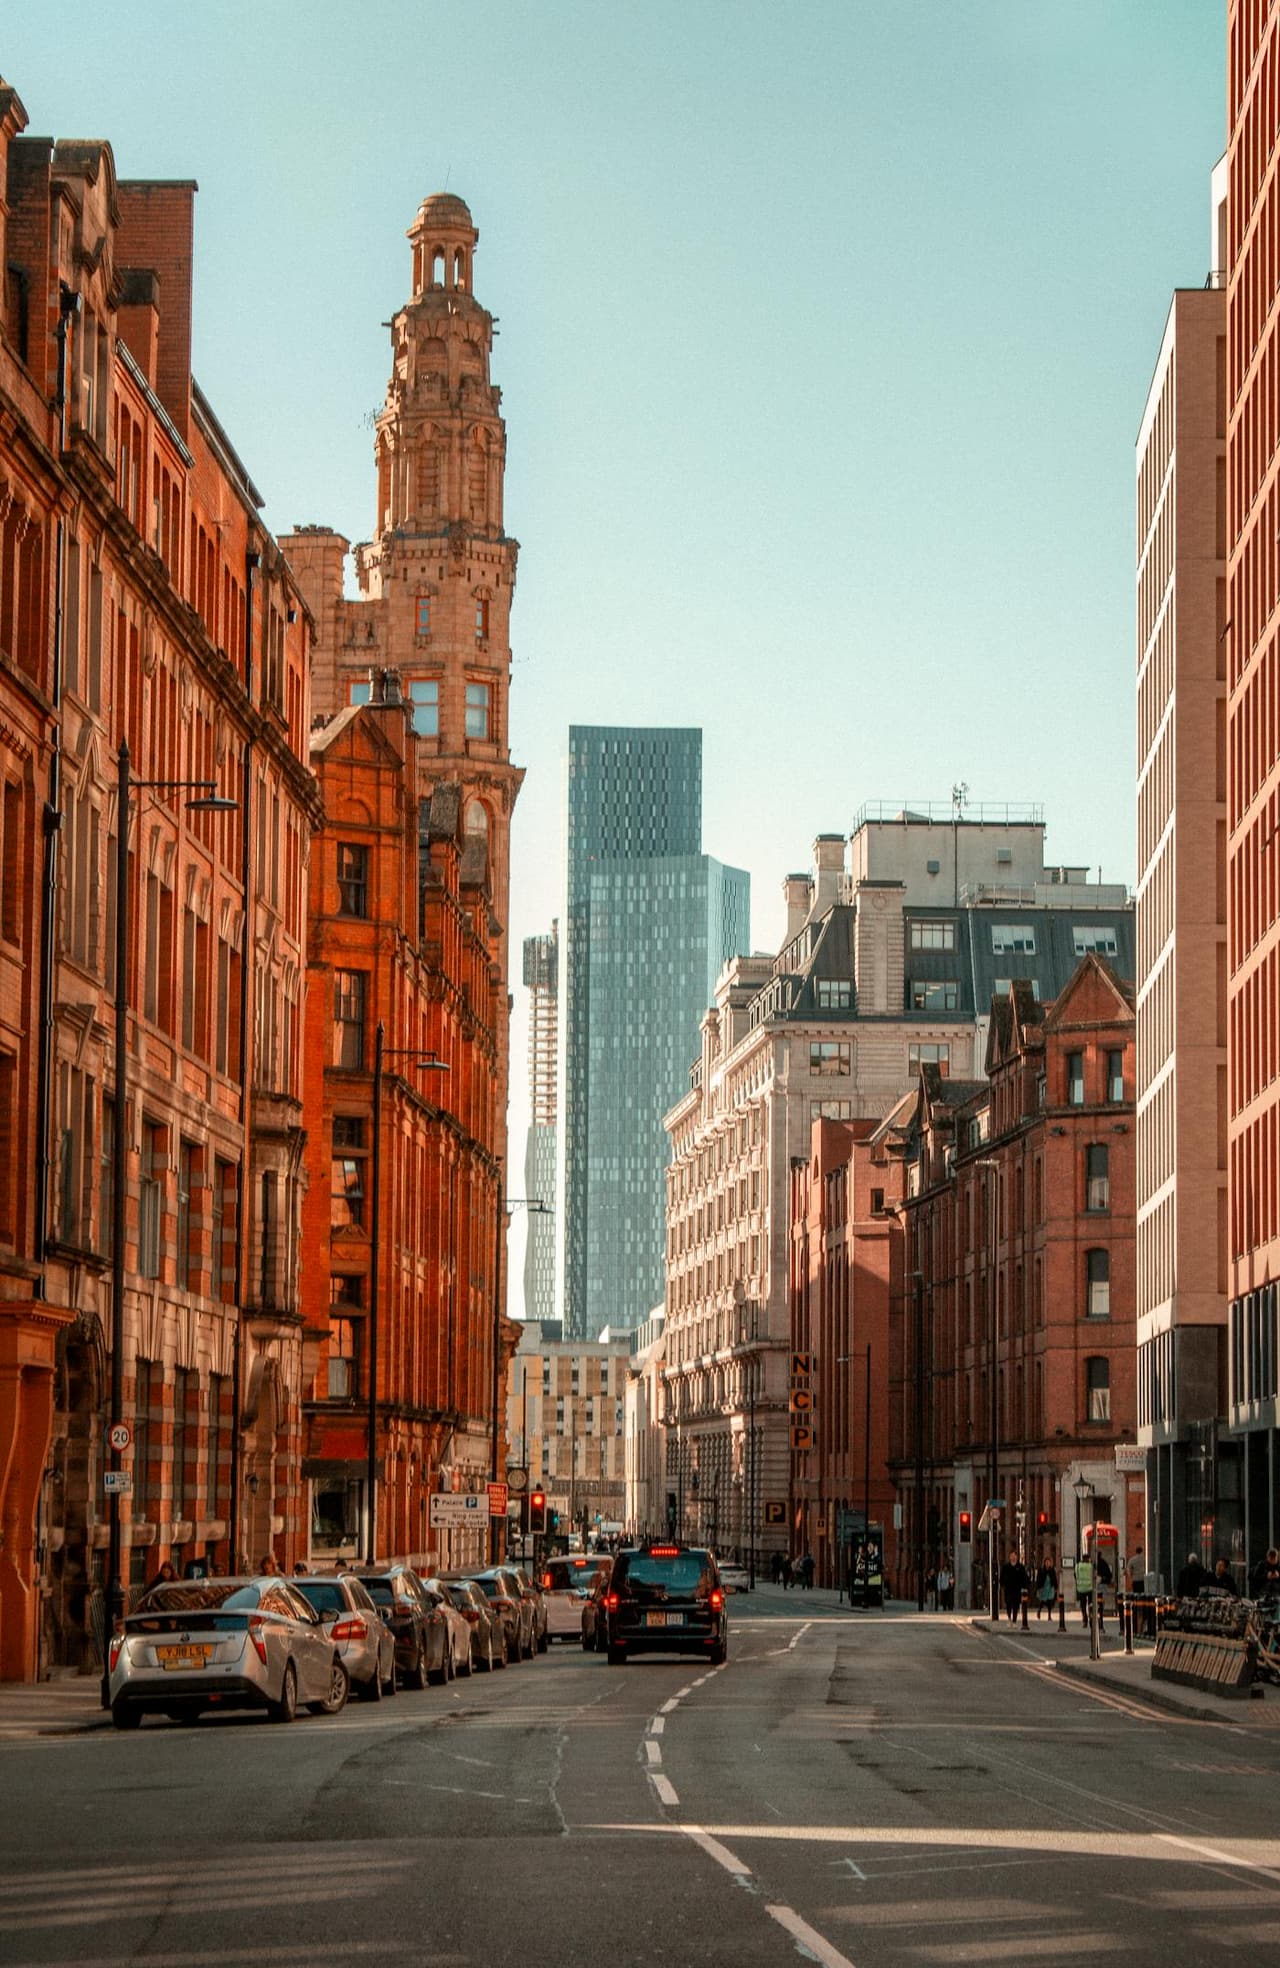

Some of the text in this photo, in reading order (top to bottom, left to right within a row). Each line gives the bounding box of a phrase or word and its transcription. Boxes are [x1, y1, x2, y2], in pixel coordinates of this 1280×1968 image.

[793, 1355, 810, 1447] NCP
[113, 1431, 128, 1442] 20
[768, 1504, 782, 1521] P
